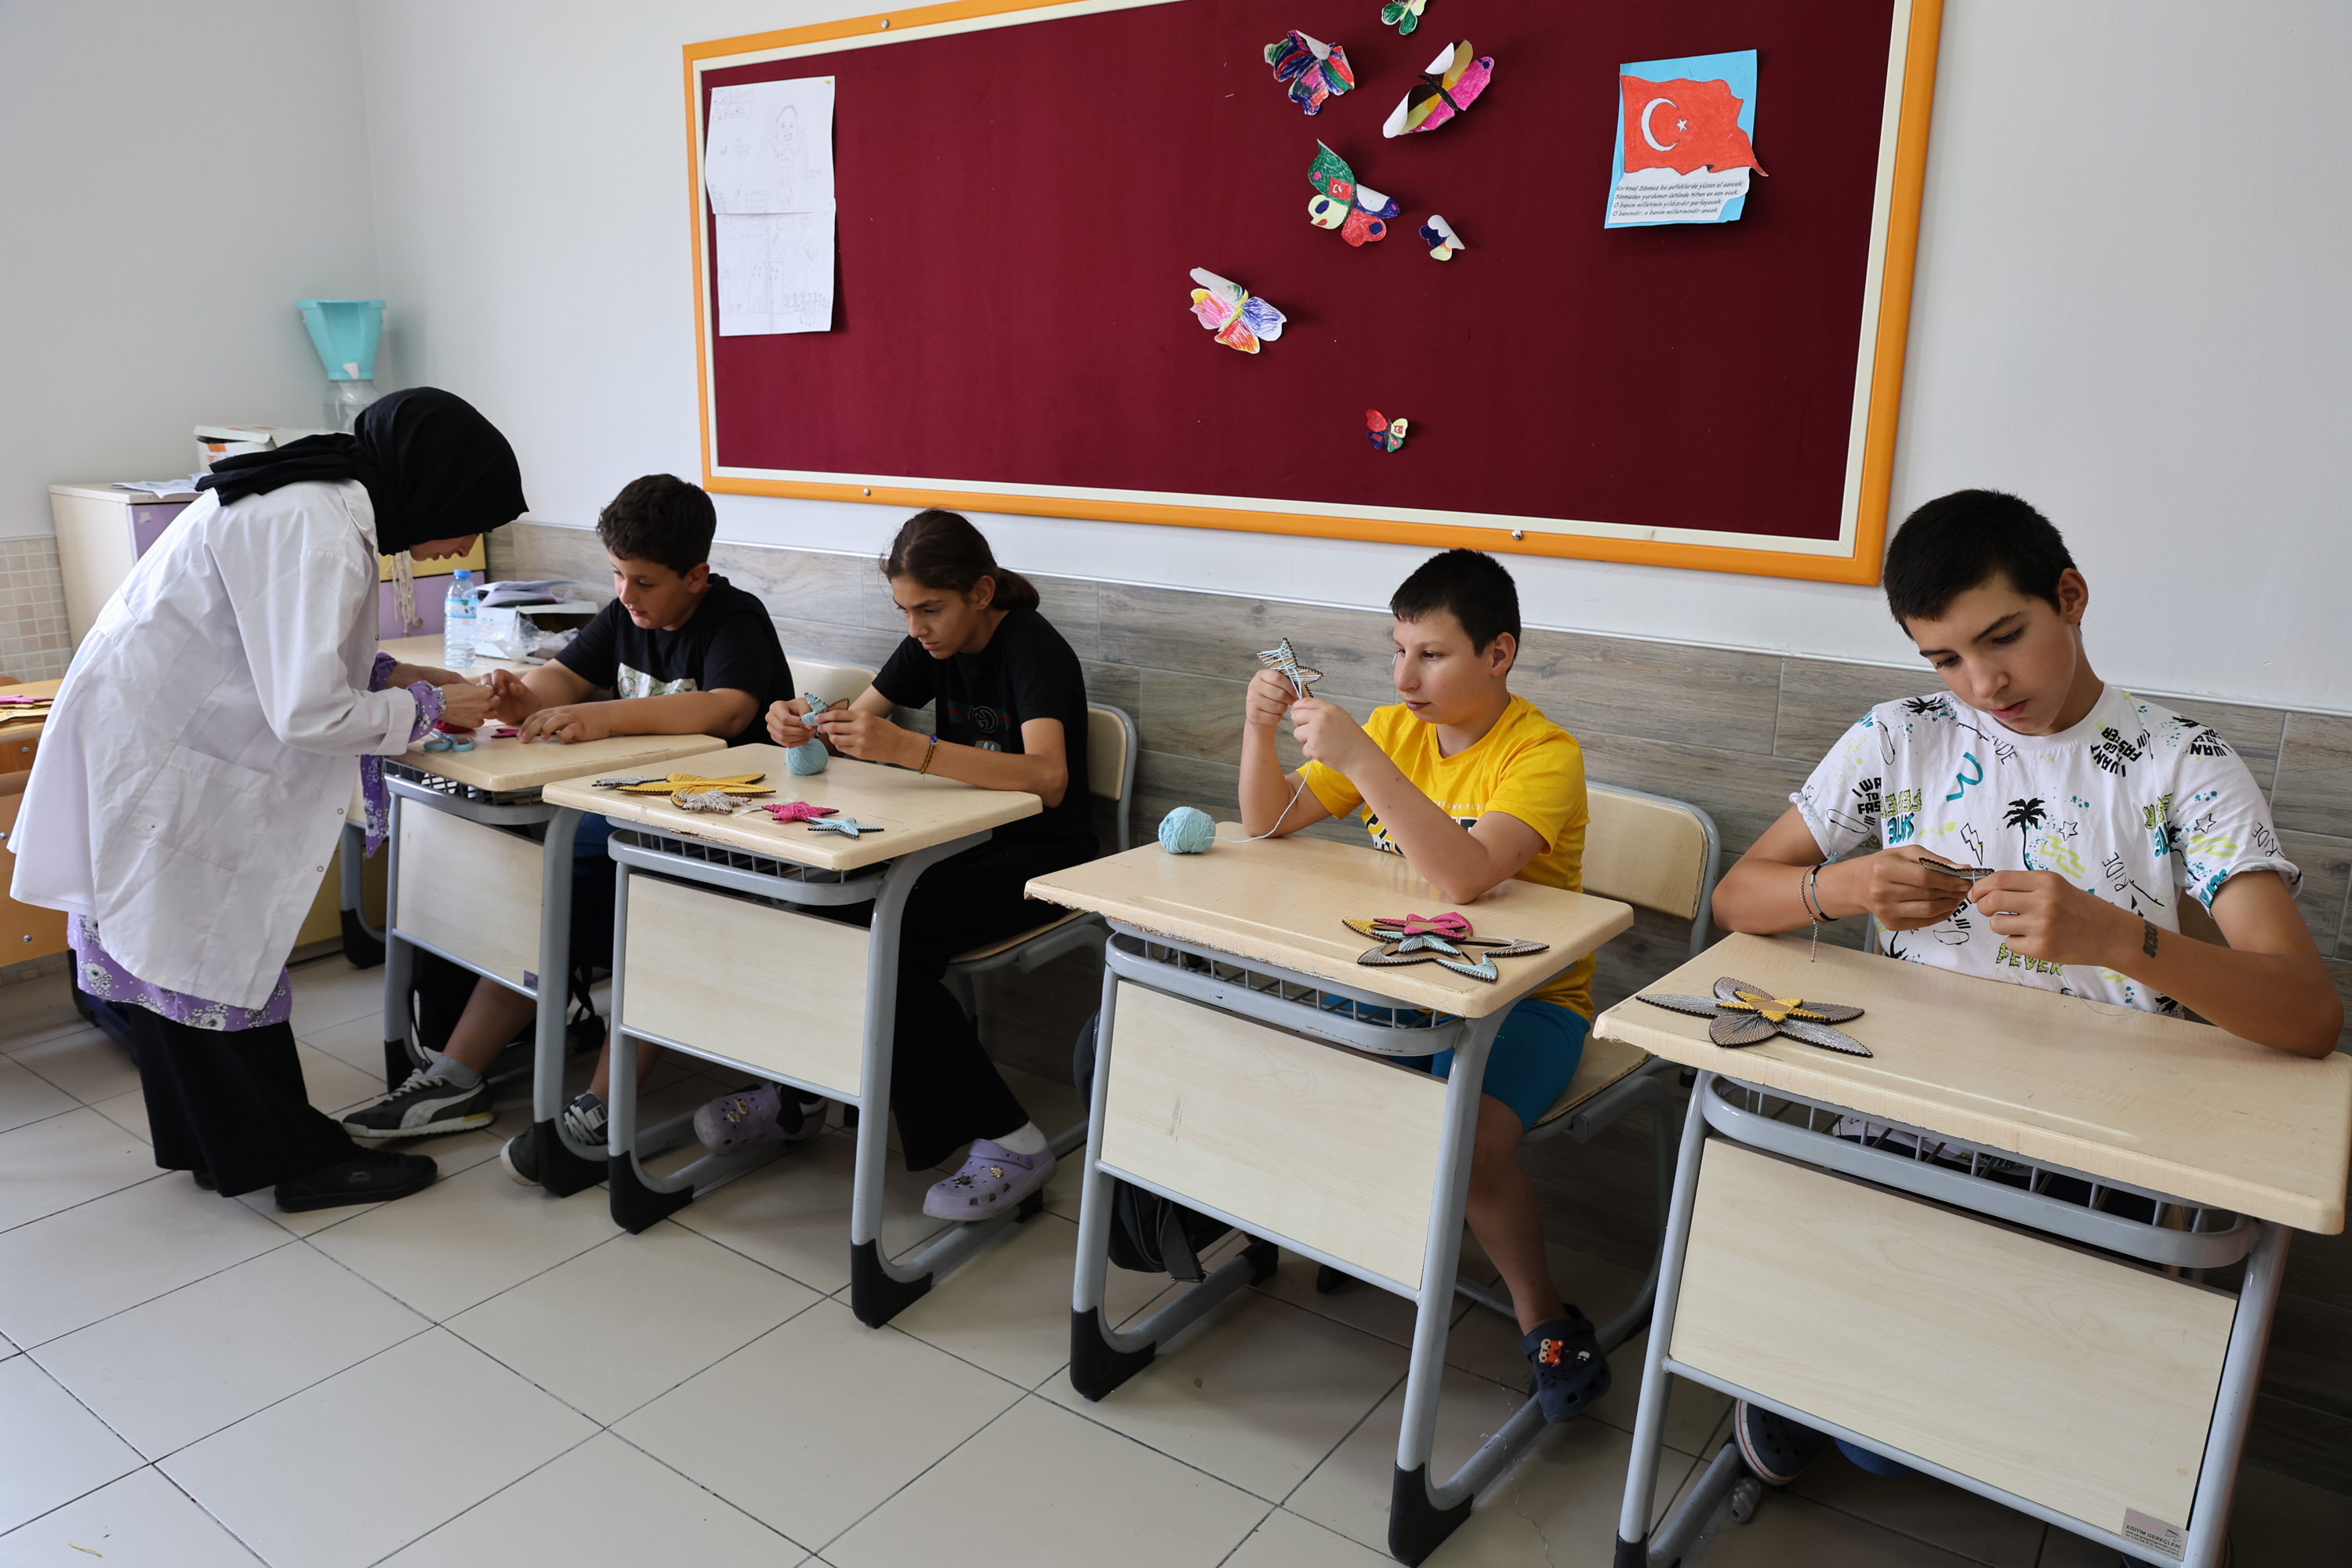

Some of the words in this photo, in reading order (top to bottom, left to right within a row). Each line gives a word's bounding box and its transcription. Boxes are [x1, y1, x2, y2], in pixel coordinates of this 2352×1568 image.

[2190, 742, 2227, 757] WAN
[1858, 777, 1882, 792] WA
[1865, 793, 1879, 801] TO
[1857, 800, 1881, 815] FAS
[2126, 1524, 2147, 1536] EĞİTİM
[2147, 1534, 2181, 1550] GEREÇLERİ
